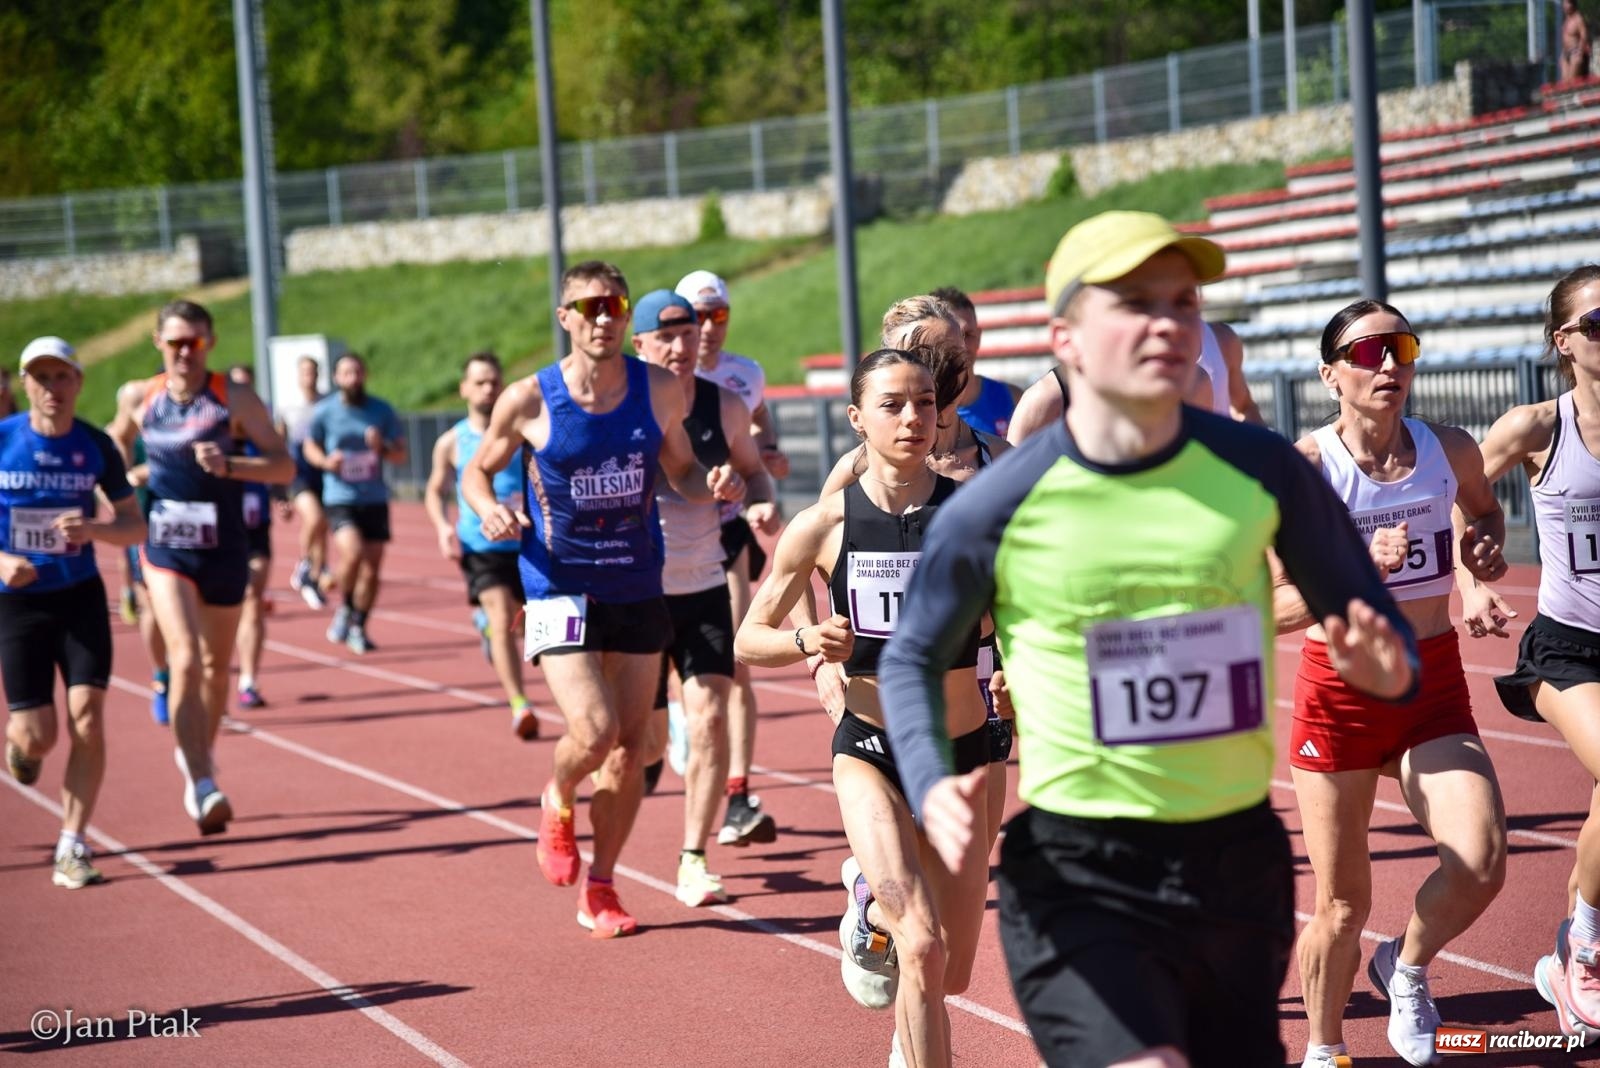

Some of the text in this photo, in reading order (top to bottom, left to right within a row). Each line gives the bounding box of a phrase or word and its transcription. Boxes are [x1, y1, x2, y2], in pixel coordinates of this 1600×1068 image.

[574, 470, 641, 497] SILESIAN
[575, 494, 642, 512] TRIATHLON TEAM
[1571, 505, 1589, 514] XVIII
[1373, 513, 1391, 524] BIEG
[1392, 510, 1406, 521] BEZ
[1407, 504, 1432, 518] GRANIC
[1571, 513, 1600, 523] 3MAJA2
[26, 528, 57, 549] 115
[856, 559, 874, 568] XVIII
[876, 559, 894, 568] BIEG
[896, 559, 910, 568] BEZ
[856, 569, 901, 578] 3MAJA2026
[1121, 672, 1210, 725] 197
